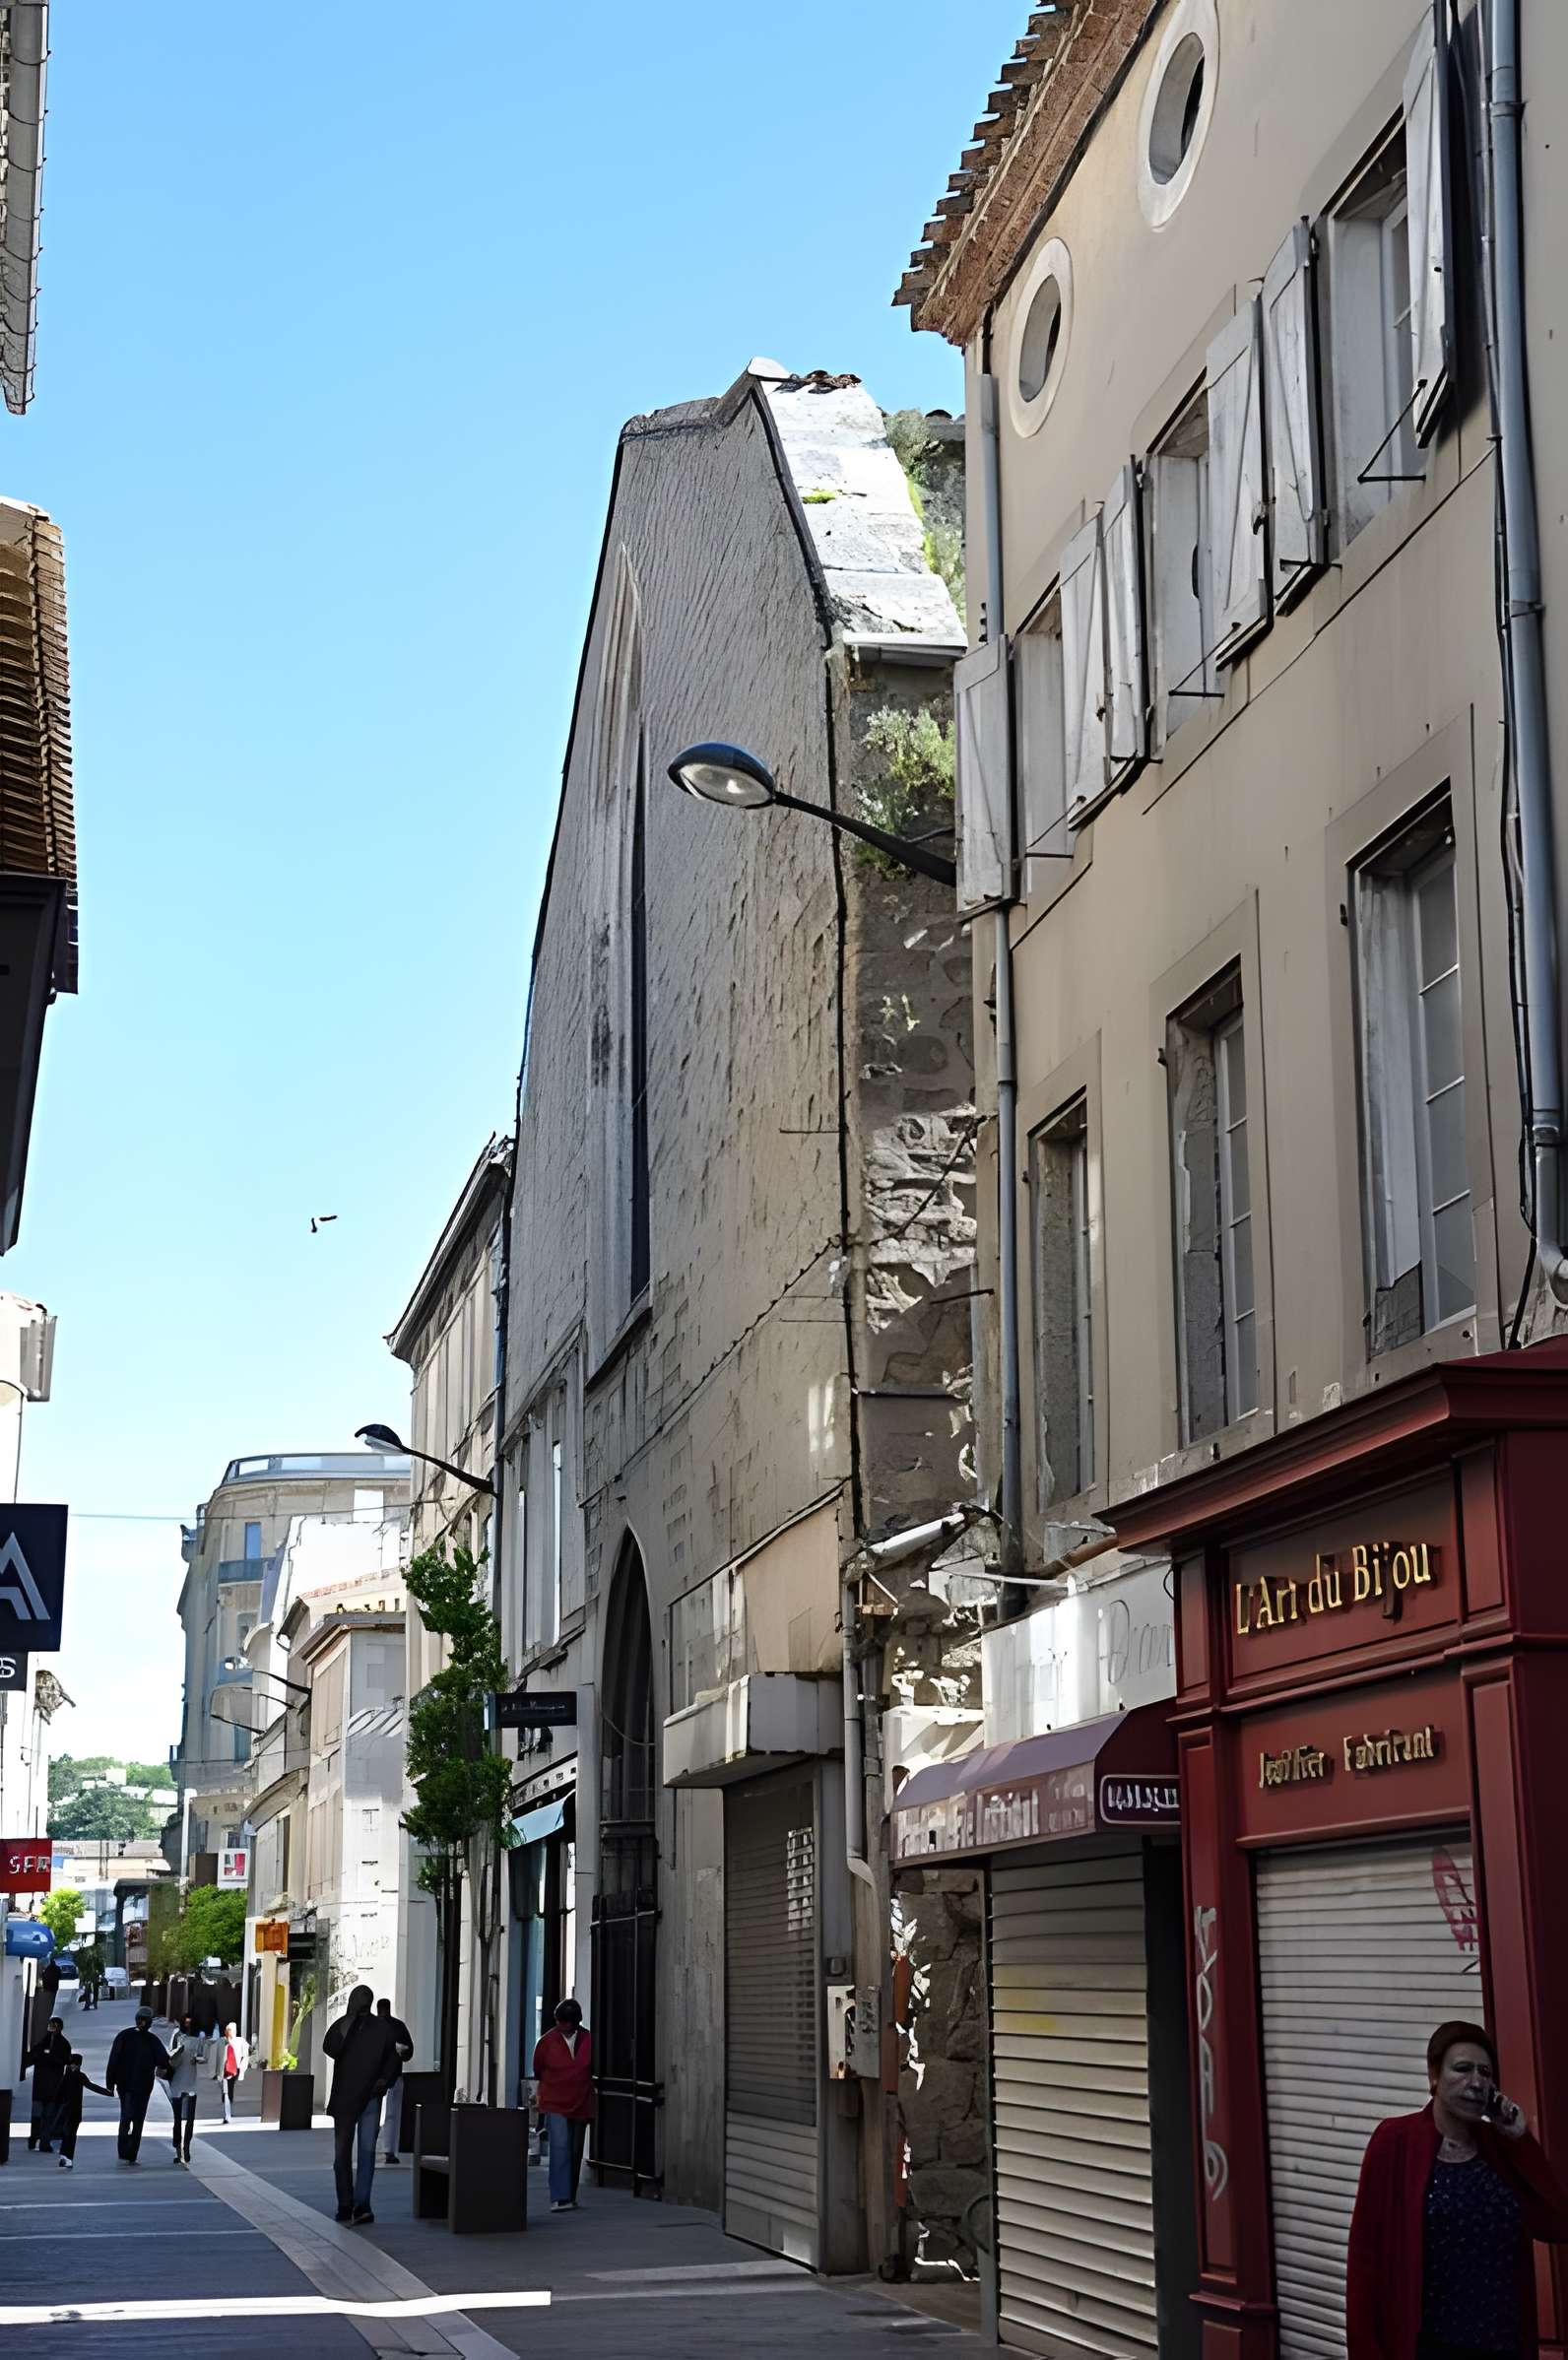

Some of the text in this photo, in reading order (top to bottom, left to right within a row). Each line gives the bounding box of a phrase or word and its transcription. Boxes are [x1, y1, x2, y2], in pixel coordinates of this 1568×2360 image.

[1236, 1541, 1431, 1634] L'Art du Bijou
